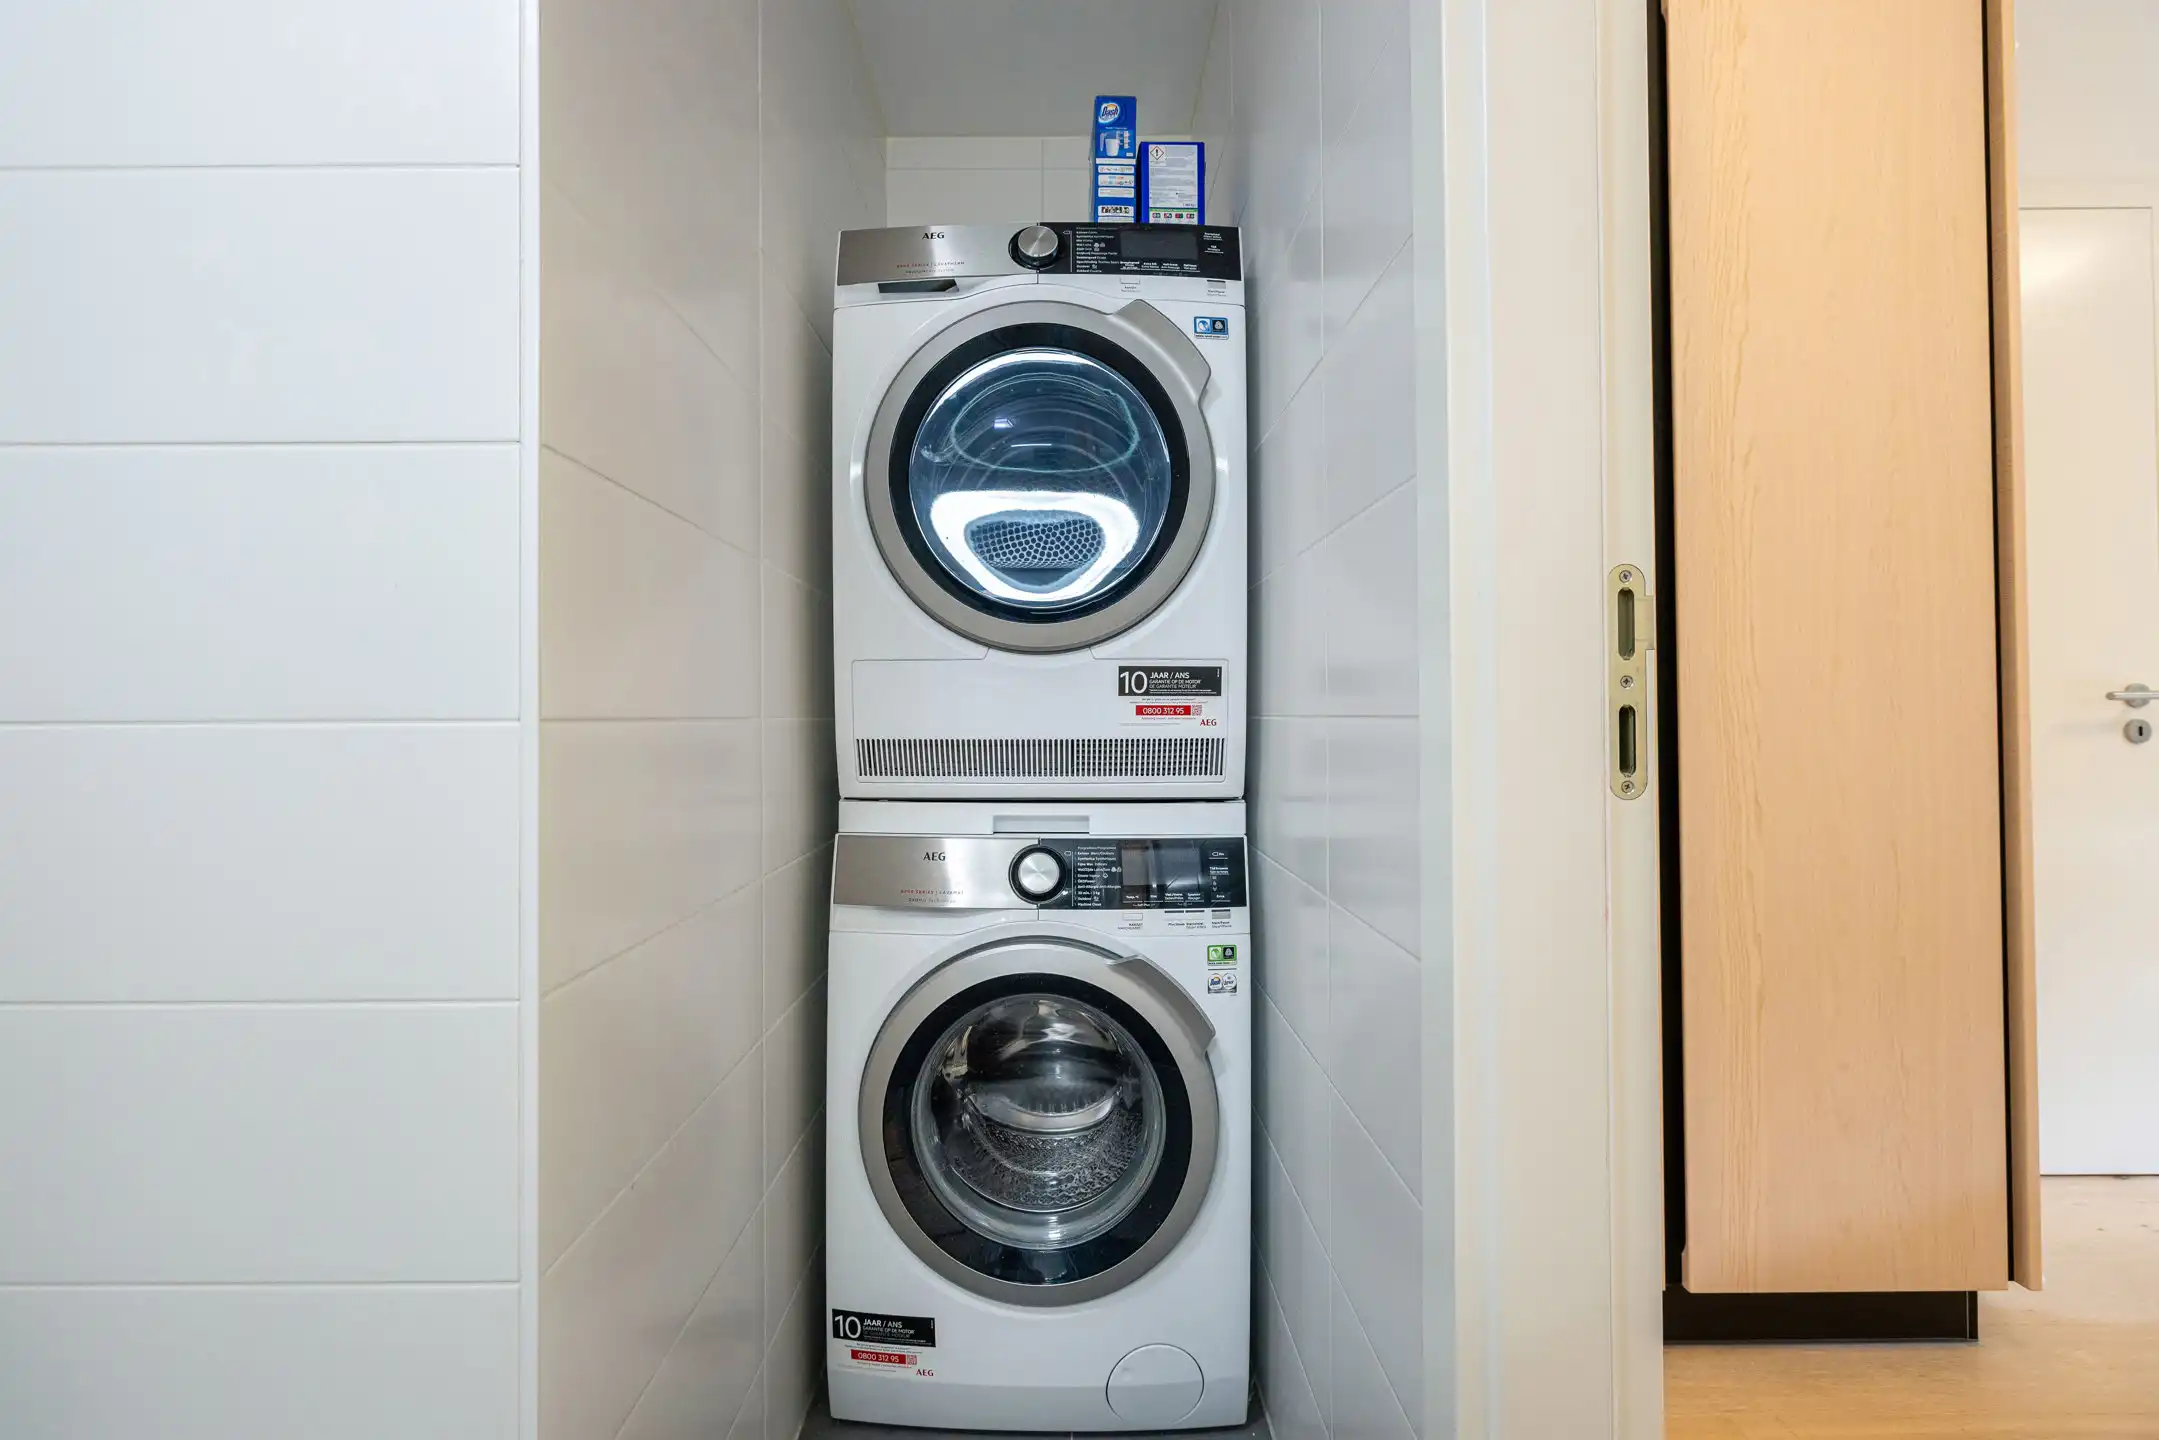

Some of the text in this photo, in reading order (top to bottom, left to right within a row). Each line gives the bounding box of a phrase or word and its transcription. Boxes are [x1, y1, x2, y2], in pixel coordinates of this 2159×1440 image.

[1102, 106, 1119, 116] Dash
[1120, 671, 1148, 694] 10
[923, 852, 946, 861] AEG
[835, 1315, 861, 1338] 10
[858, 1352, 876, 1360] 0800
